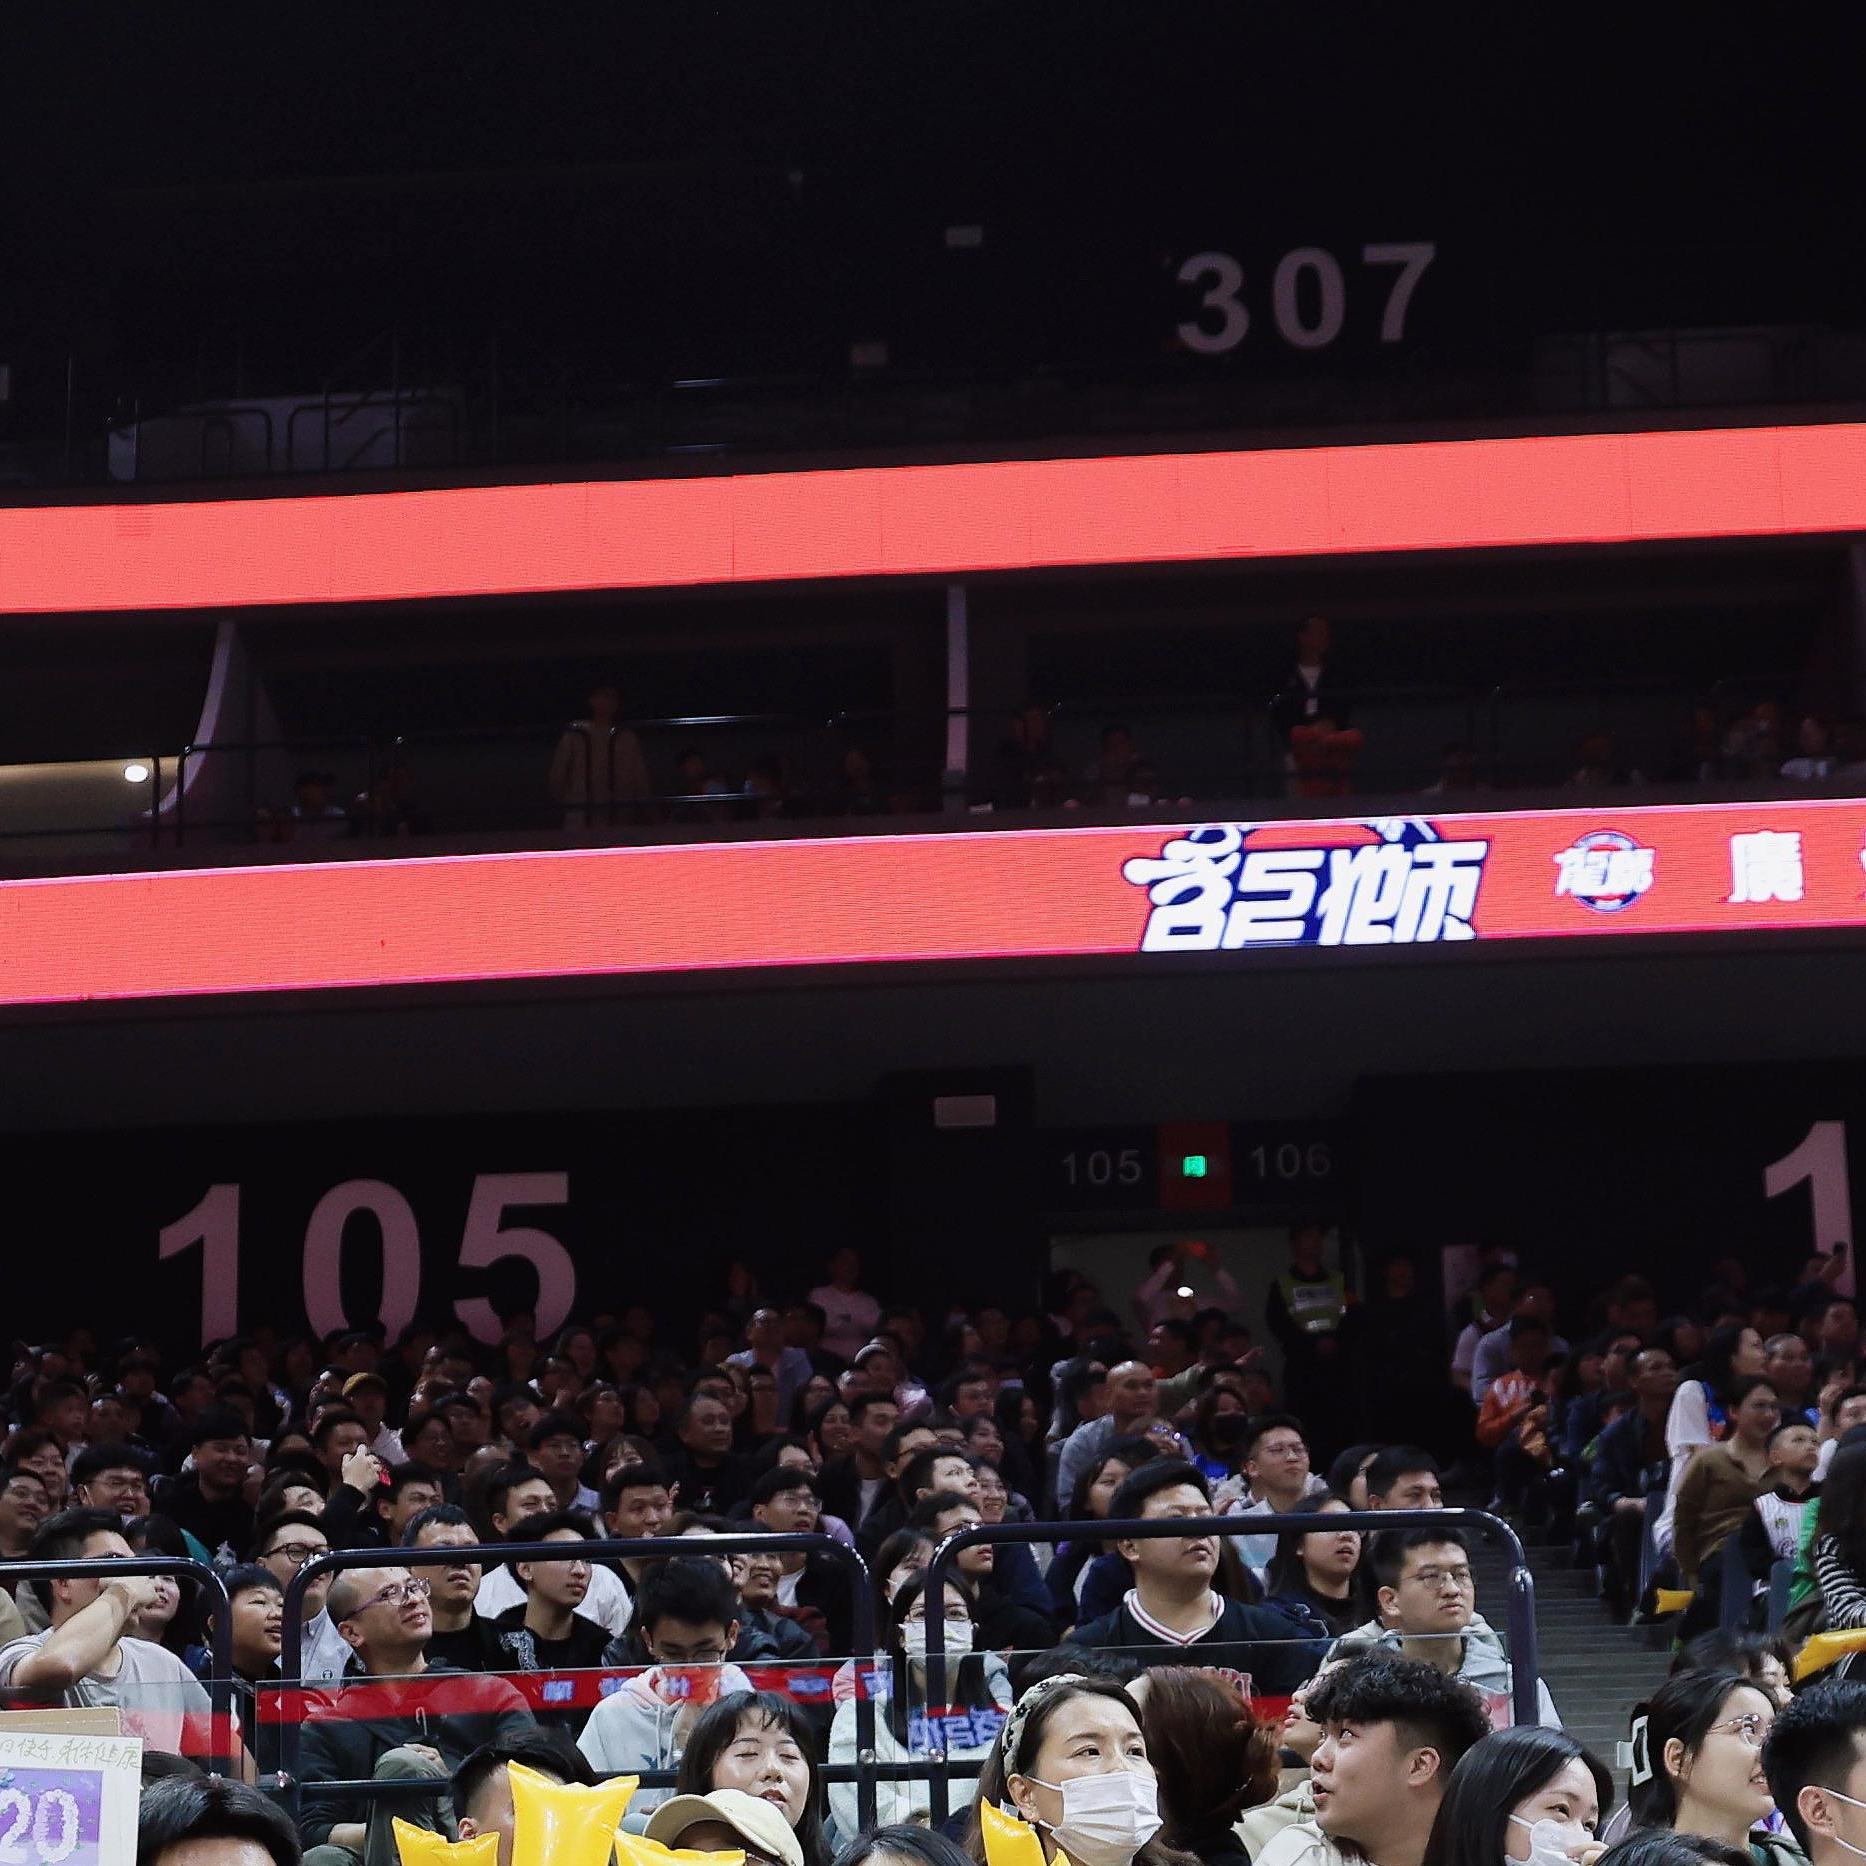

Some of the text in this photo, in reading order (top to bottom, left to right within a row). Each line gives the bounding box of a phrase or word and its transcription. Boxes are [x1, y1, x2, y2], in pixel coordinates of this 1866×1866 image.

[1175, 242, 1439, 356] 307
[1059, 1148, 1143, 1188] 105
[1247, 1140, 1334, 1180] 106
[158, 1171, 578, 1350] 105
